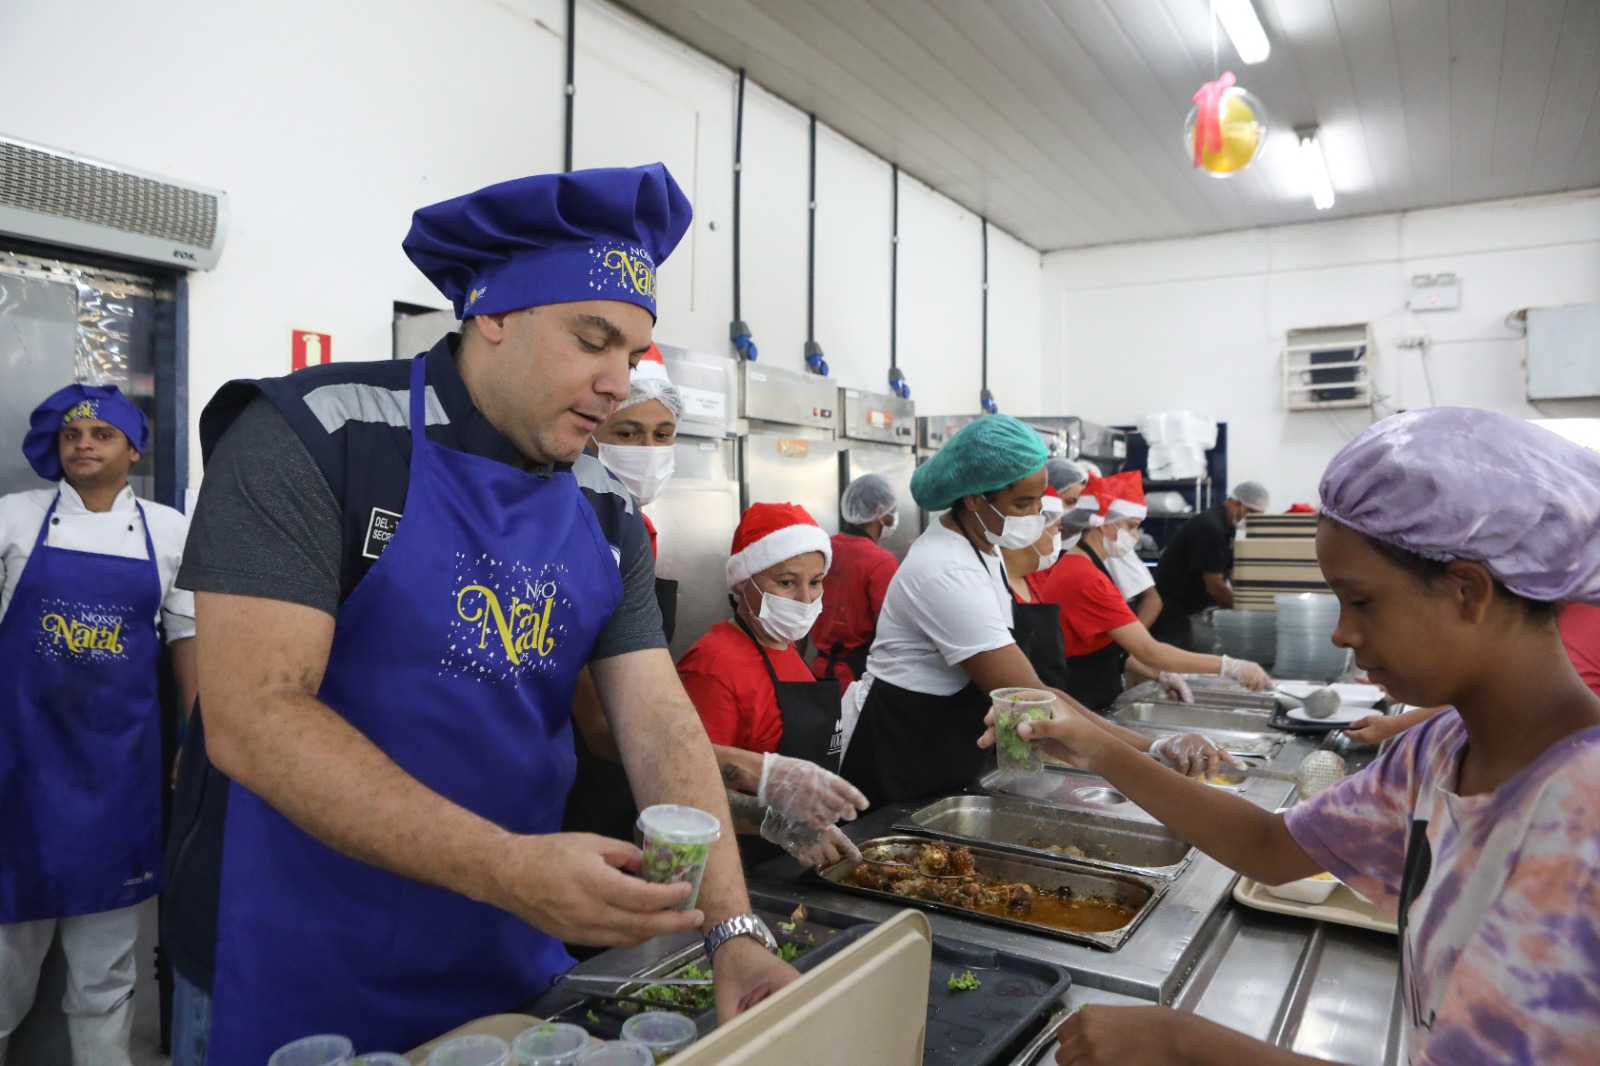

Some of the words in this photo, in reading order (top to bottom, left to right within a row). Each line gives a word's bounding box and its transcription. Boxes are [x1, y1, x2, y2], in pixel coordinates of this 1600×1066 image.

[375, 516, 389, 529] DEL
[372, 529, 395, 542] SECR
[81, 611, 123, 628] NOSSO
[42, 613, 124, 654] Natal
